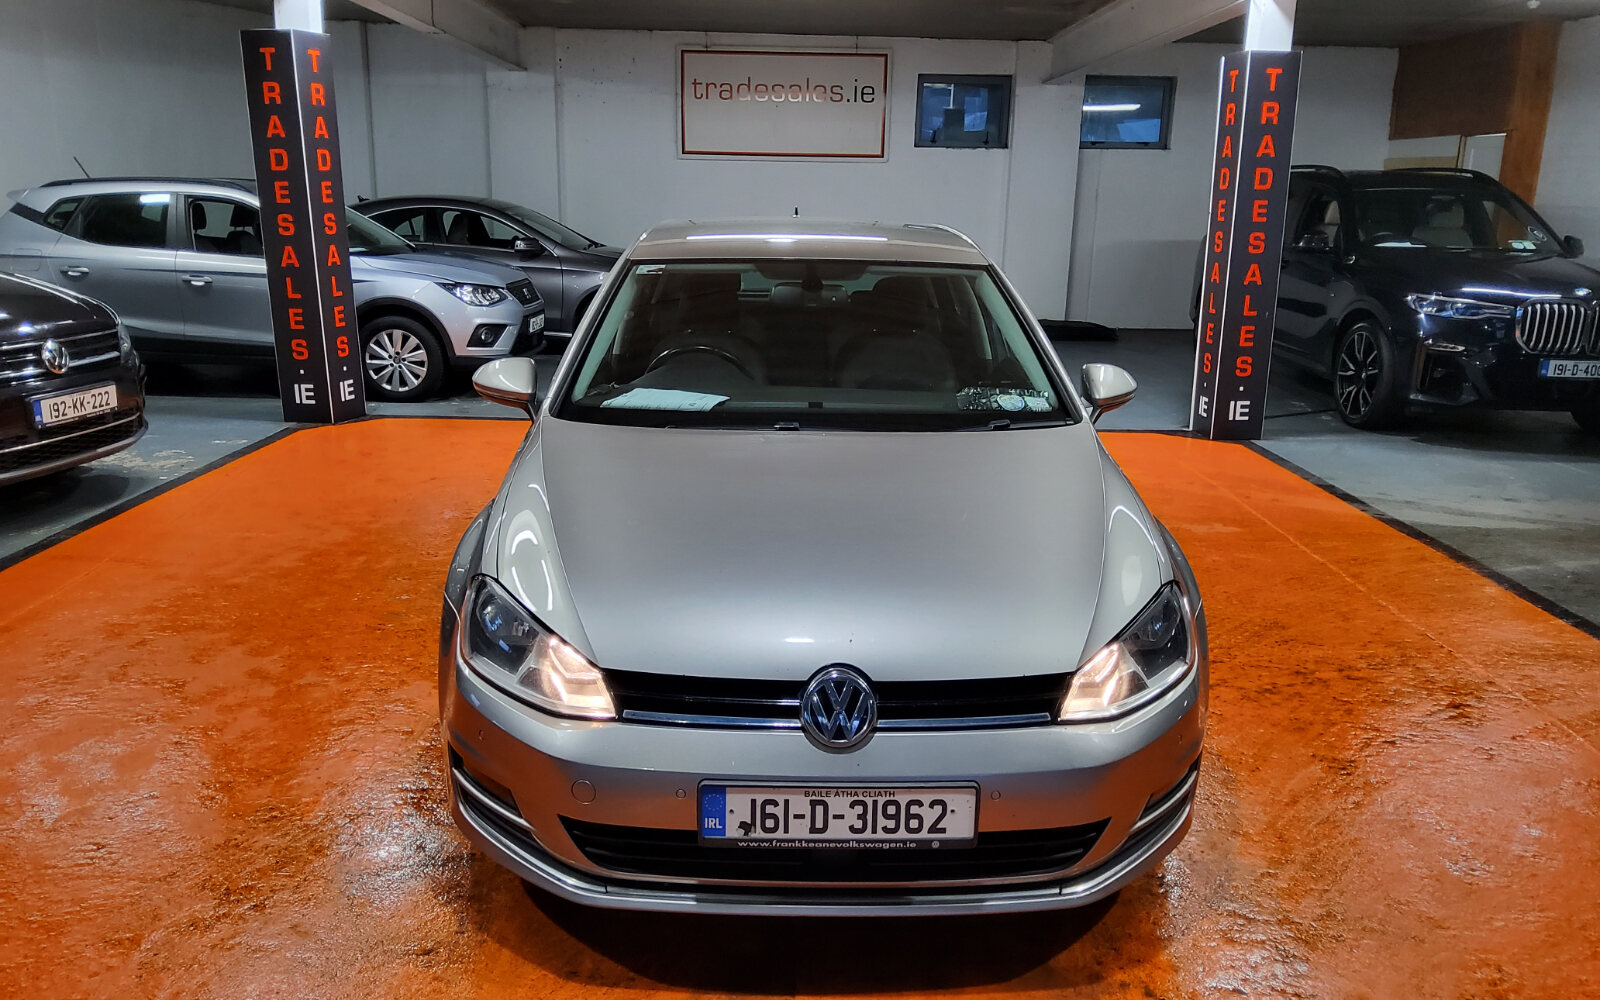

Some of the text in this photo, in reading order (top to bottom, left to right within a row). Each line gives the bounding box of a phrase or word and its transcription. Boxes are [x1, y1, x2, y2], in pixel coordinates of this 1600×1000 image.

[692, 76, 876, 104] tradesales.ie
[49, 390, 111, 420] 192-KK-222
[804, 790, 832, 798] BAILE
[861, 790, 896, 798] CLIATH
[704, 817, 724, 829] IRL
[750, 798, 948, 836] 161-D-31962
[737, 840, 918, 849] www.frankkeanevolkswagen.ie
